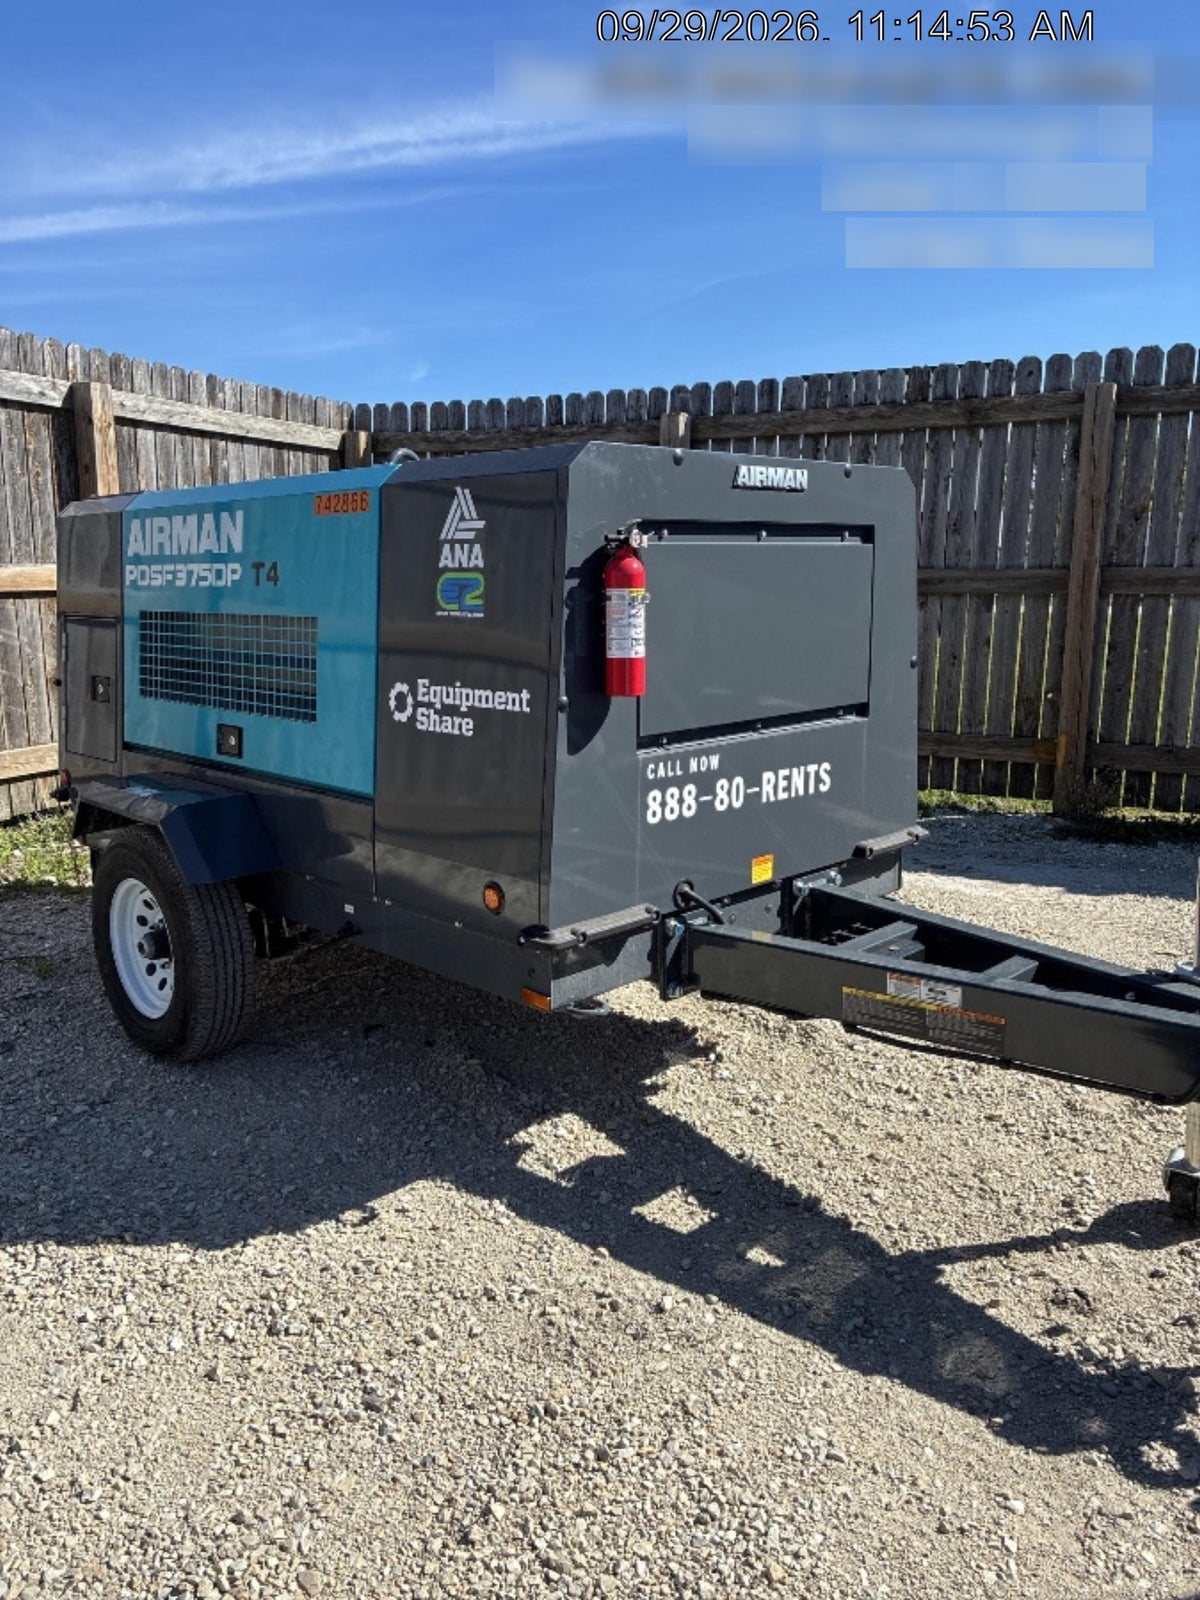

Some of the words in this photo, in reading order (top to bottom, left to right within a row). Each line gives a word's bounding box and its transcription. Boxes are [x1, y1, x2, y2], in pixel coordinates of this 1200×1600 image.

[737, 465, 808, 490] AIRMAN
[315, 490, 369, 514] 742866
[127, 510, 244, 557] AIRMAN
[438, 543, 484, 568] ANA
[252, 561, 280, 587] T4
[417, 678, 531, 713] Equipment
[415, 707, 474, 737] Share
[646, 760, 684, 780] CALL
[689, 753, 721, 773] NOW
[646, 762, 832, 825] 888-80-RENTS
